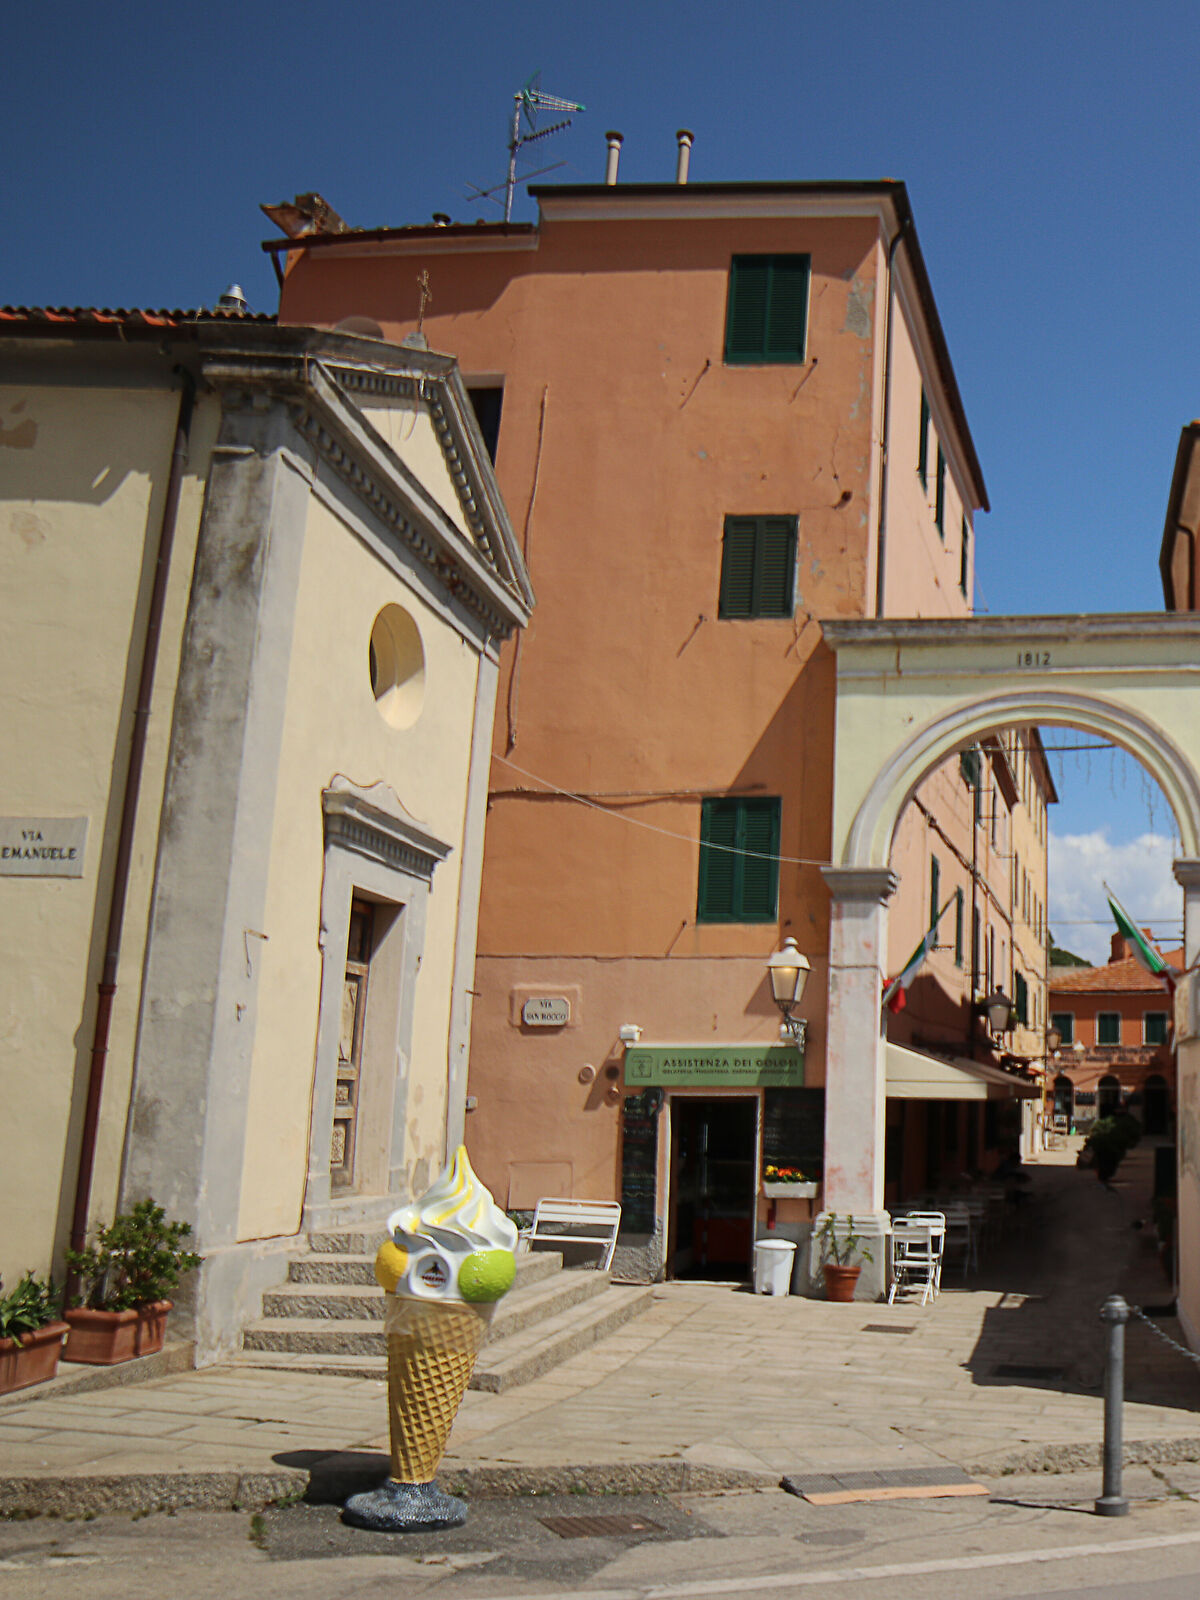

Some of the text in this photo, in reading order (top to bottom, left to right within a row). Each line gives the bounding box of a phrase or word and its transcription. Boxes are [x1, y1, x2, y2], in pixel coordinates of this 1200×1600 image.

[1017, 652, 1051, 667] 1812
[21, 830, 44, 841] VIA
[1, 847, 77, 860] EMANUELE
[540, 1000, 553, 1009] VIA
[526, 1013, 567, 1021] SAN ROCCO
[663, 1058, 729, 1068] ASSISTENZA
[734, 1058, 752, 1068] DEI
